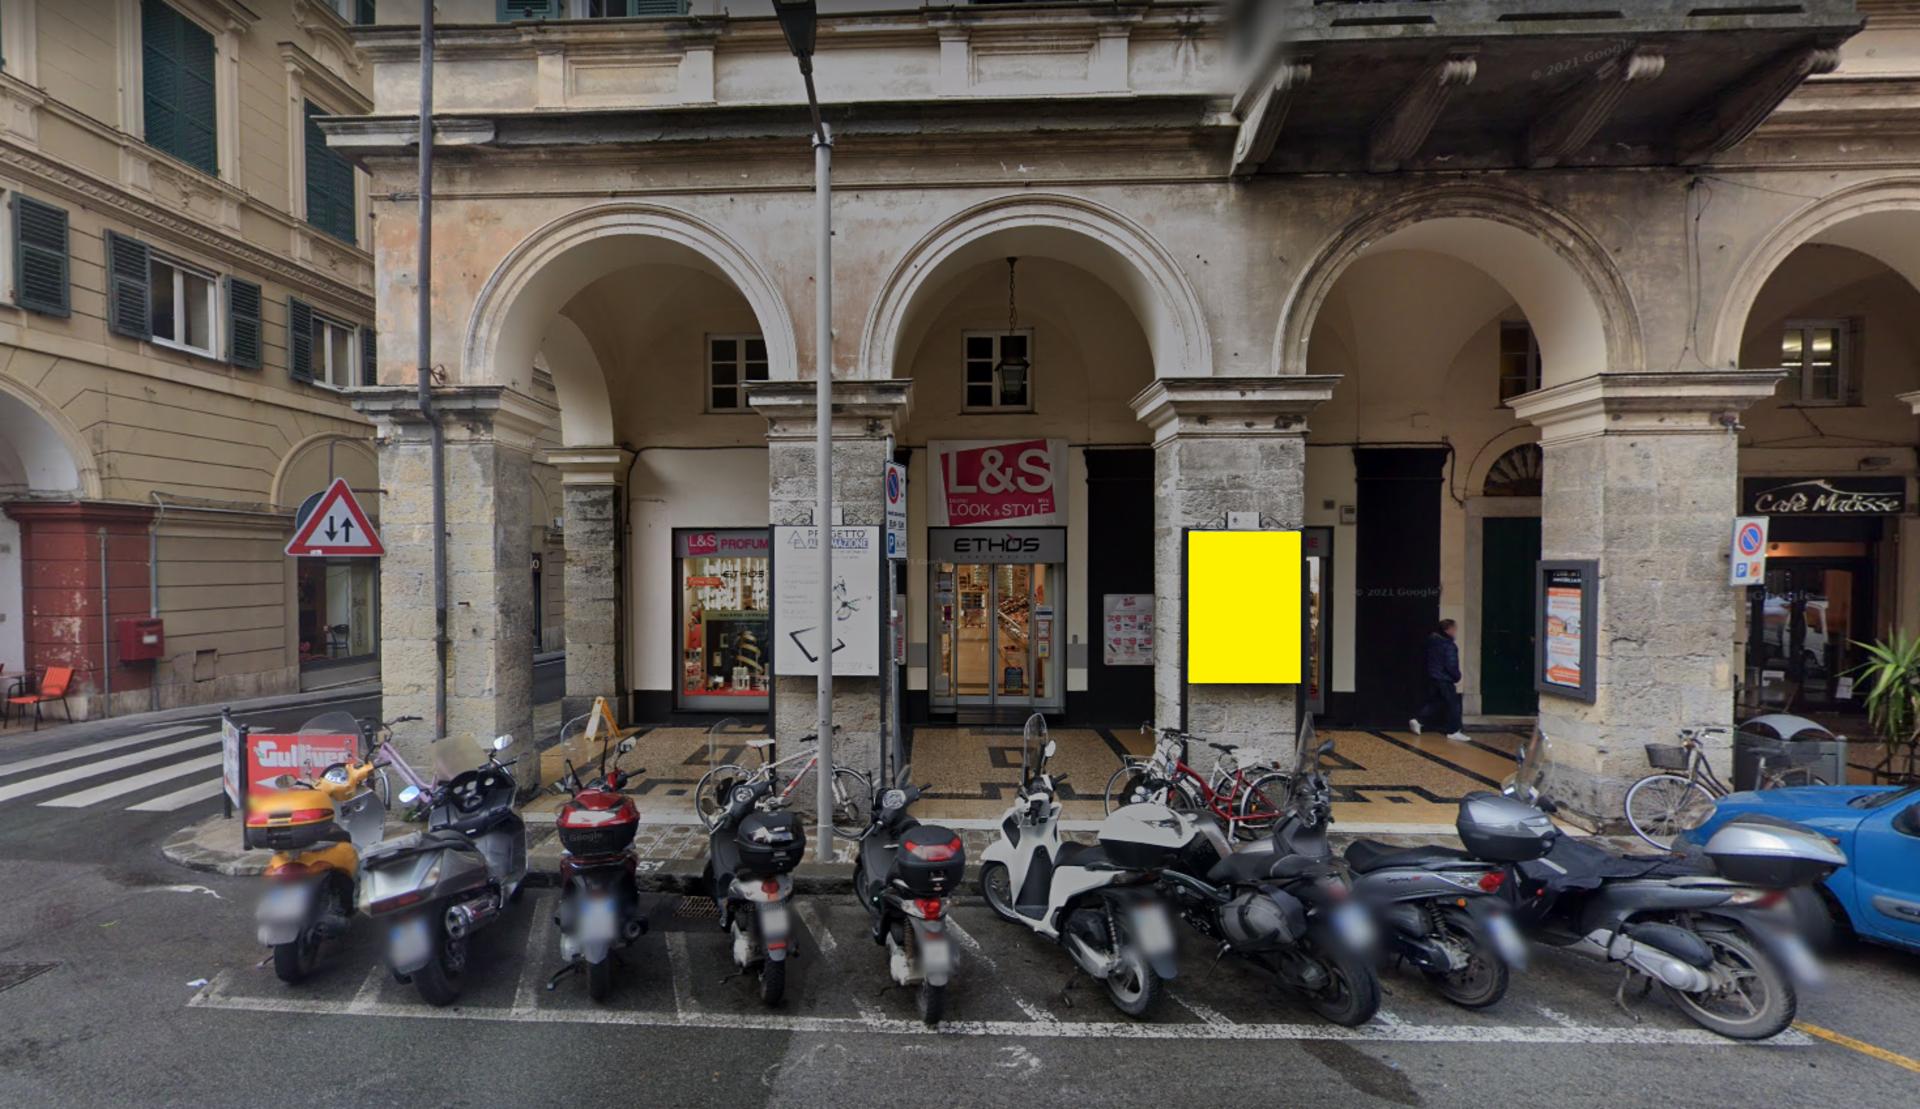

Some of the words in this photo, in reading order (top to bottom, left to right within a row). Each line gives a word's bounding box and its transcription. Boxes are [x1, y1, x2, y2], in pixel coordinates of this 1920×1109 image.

[948, 448, 1055, 494] L&S
[949, 503, 991, 517] LOOK
[1001, 503, 1050, 517] STYLE
[1811, 493, 1901, 512] Matisse
[688, 534, 716, 547] L&S
[253, 740, 346, 767] Gulliver
